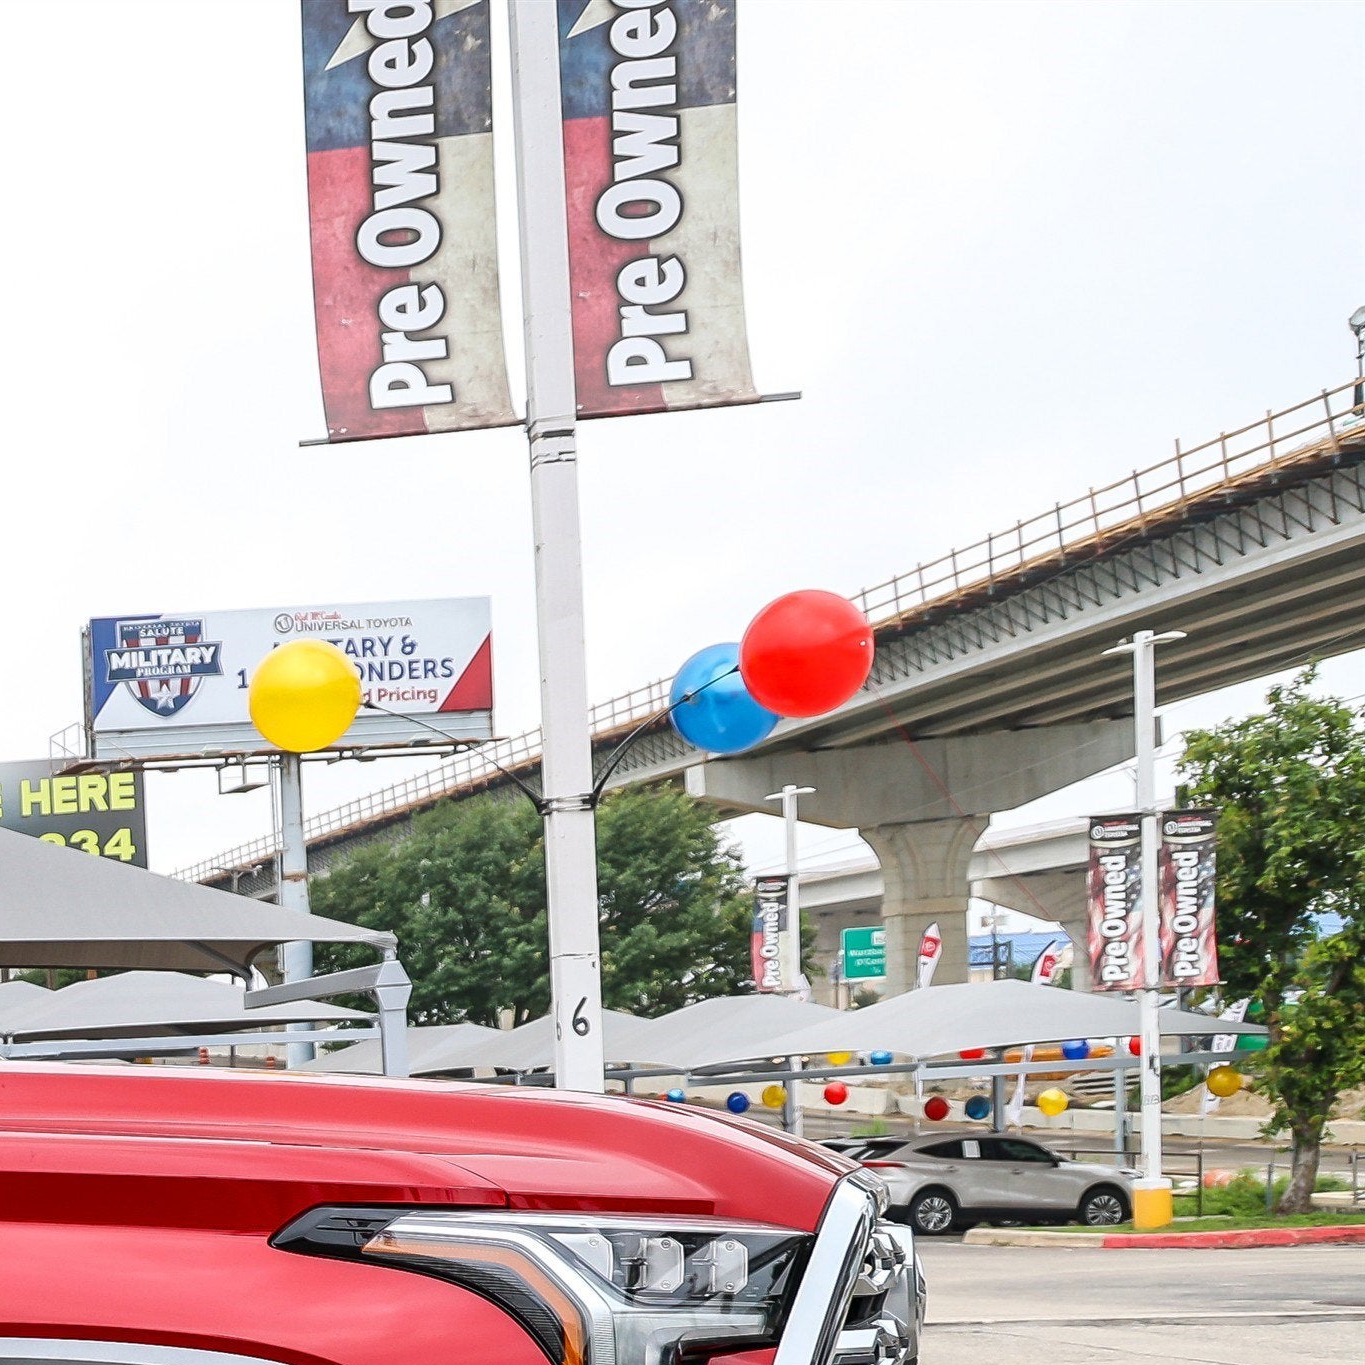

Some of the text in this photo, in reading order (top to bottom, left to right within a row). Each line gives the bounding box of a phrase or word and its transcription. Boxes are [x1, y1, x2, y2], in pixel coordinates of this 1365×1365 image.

[597, 0, 693, 386] Pre Owne
[370, 283, 454, 409] Pre
[139, 626, 184, 638] SALUTE
[295, 617, 412, 632] UNIVERSAL TOYOTA
[110, 646, 216, 671] MILITARY
[135, 664, 192, 677] PROGRAM
[377, 686, 438, 703] Pricing
[20, 772, 136, 818] HERE
[1099, 854, 1128, 938] Owned
[1171, 850, 1200, 934] Owned
[759, 901, 779, 959] Owned
[1102, 940, 1129, 982] Pre
[1173, 936, 1200, 977] Pre
[572, 996, 590, 1037] 6
